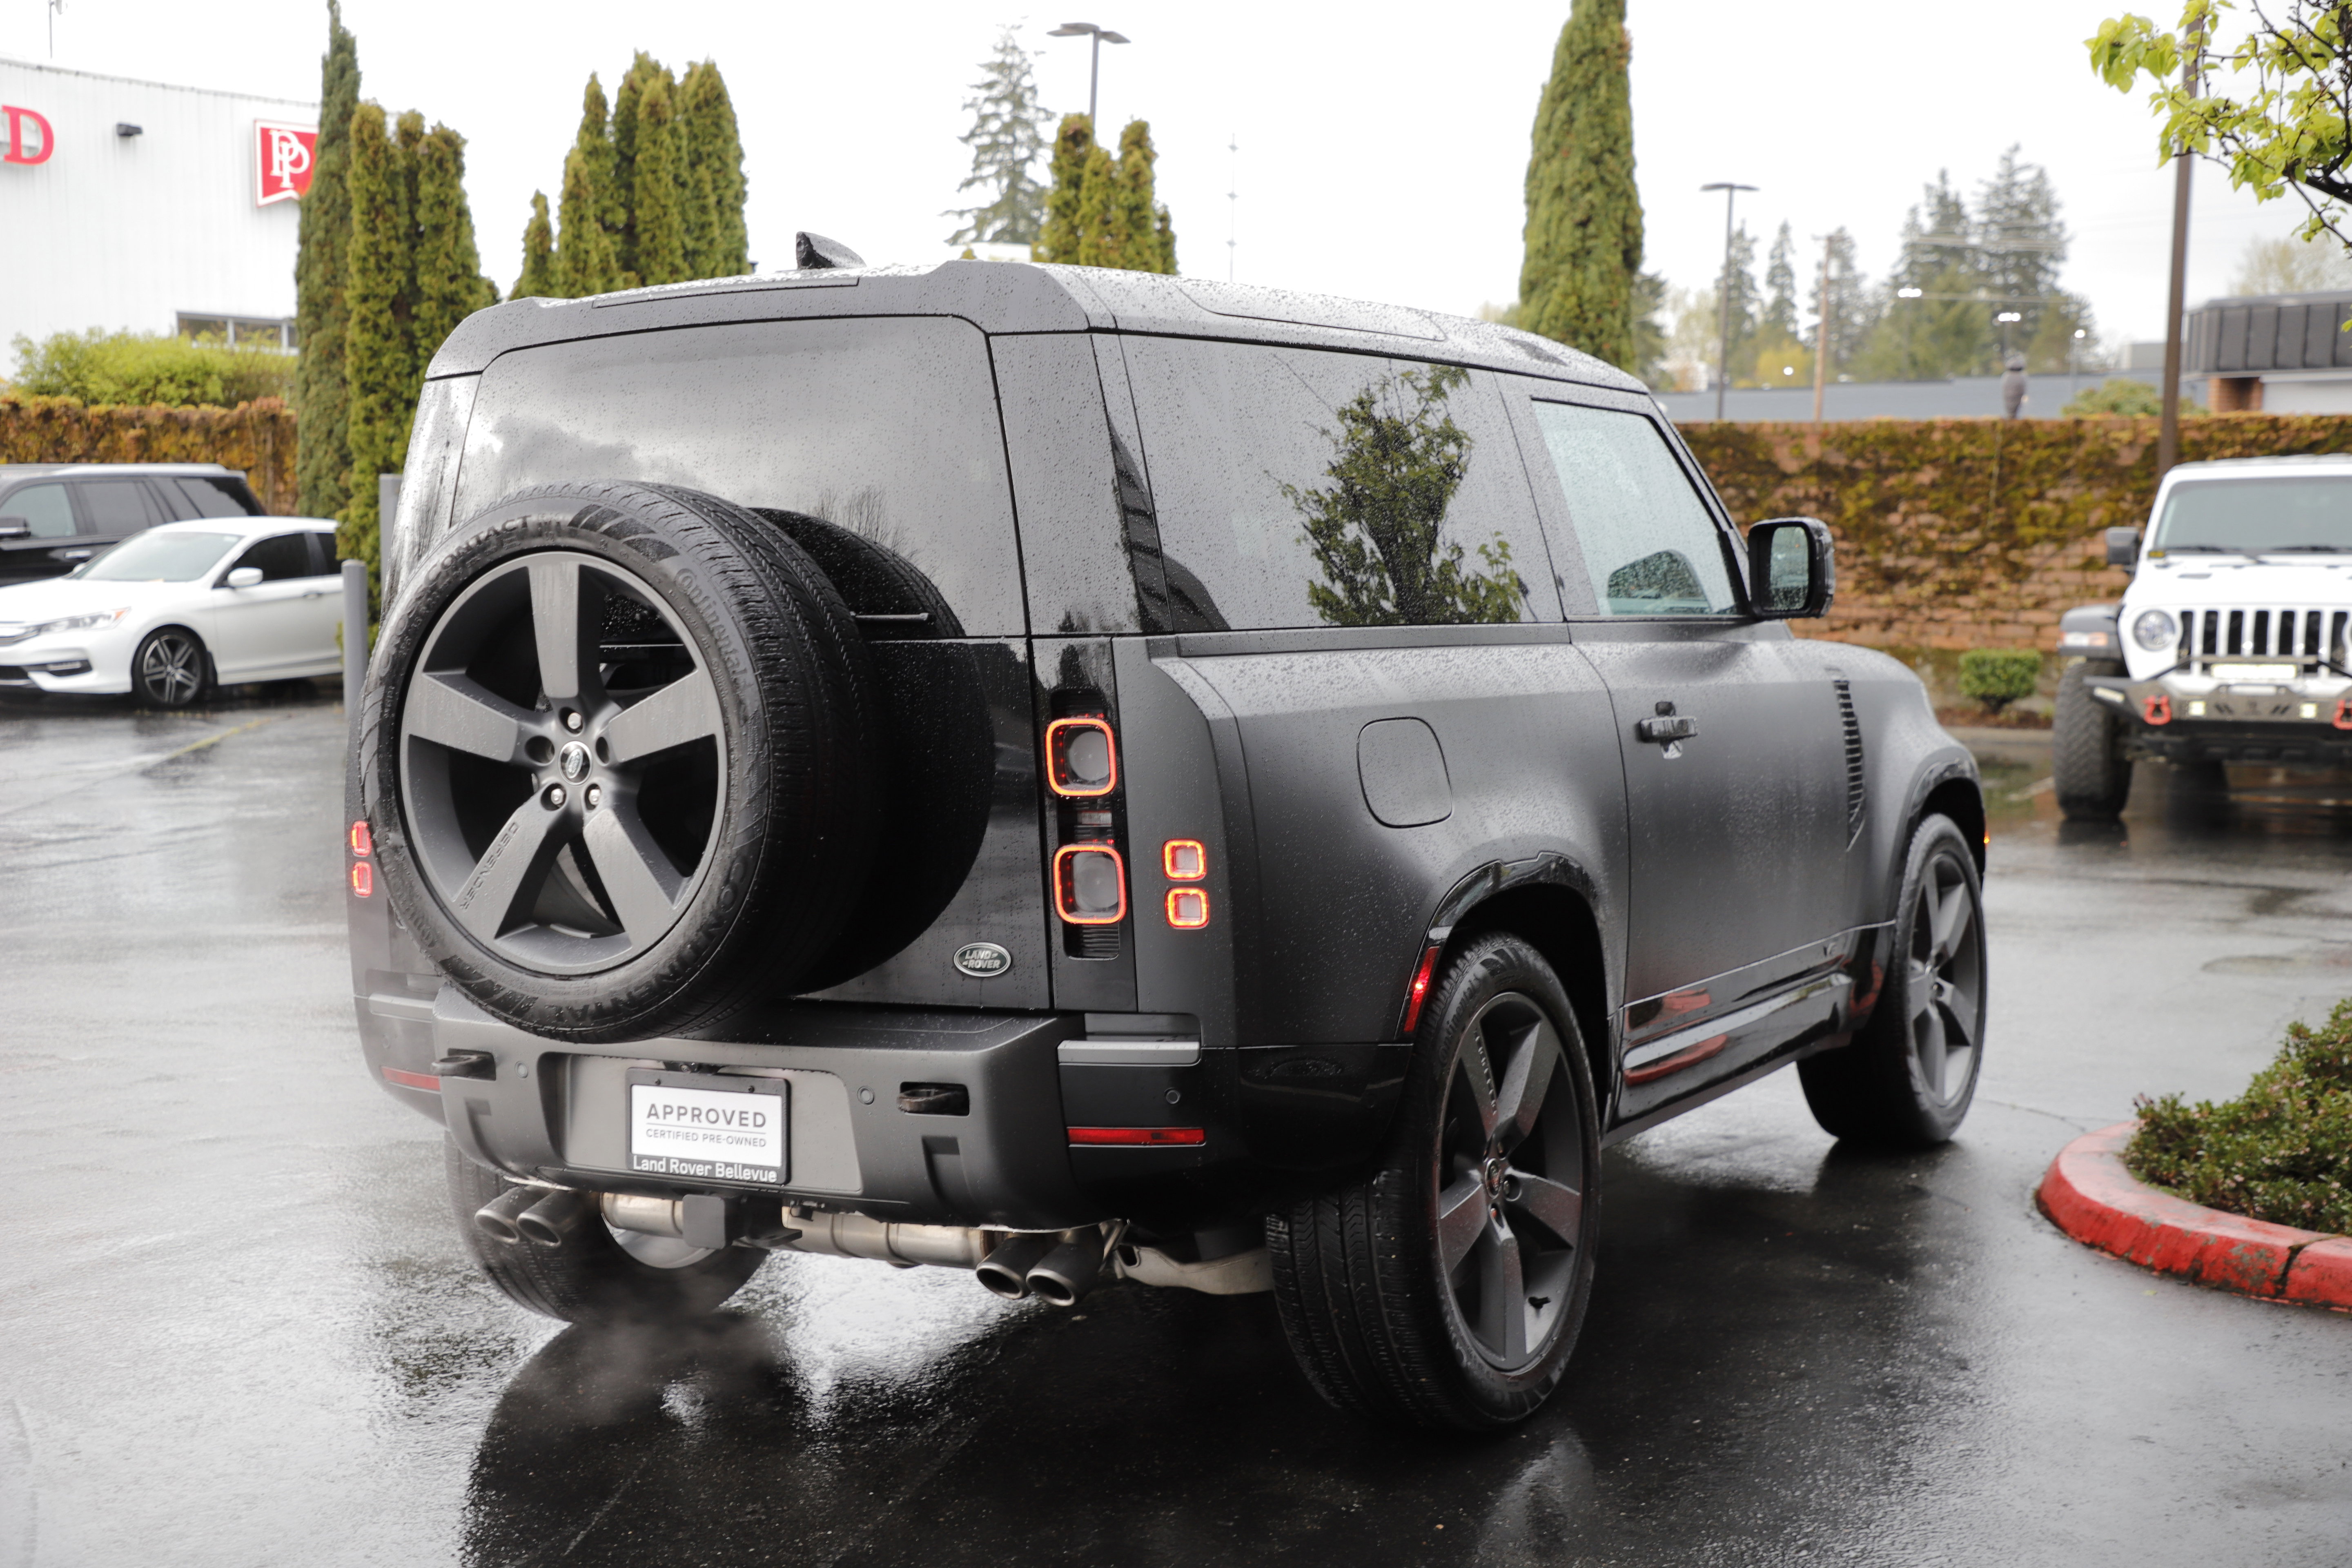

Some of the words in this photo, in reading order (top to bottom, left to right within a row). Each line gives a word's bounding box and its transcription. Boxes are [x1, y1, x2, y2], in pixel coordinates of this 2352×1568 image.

[675, 568, 748, 678] Continental
[459, 822, 519, 911] DEFENDER
[965, 950, 992, 960] LAND
[968, 960, 1001, 969] ROVER
[646, 1103, 766, 1128] APPROVED
[646, 1129, 699, 1141] CERTIFIED
[702, 1134, 766, 1147] PRE-OWNED
[633, 1155, 666, 1172] Land
[670, 1158, 713, 1176] Rover
[715, 1163, 777, 1183] Bellevue
